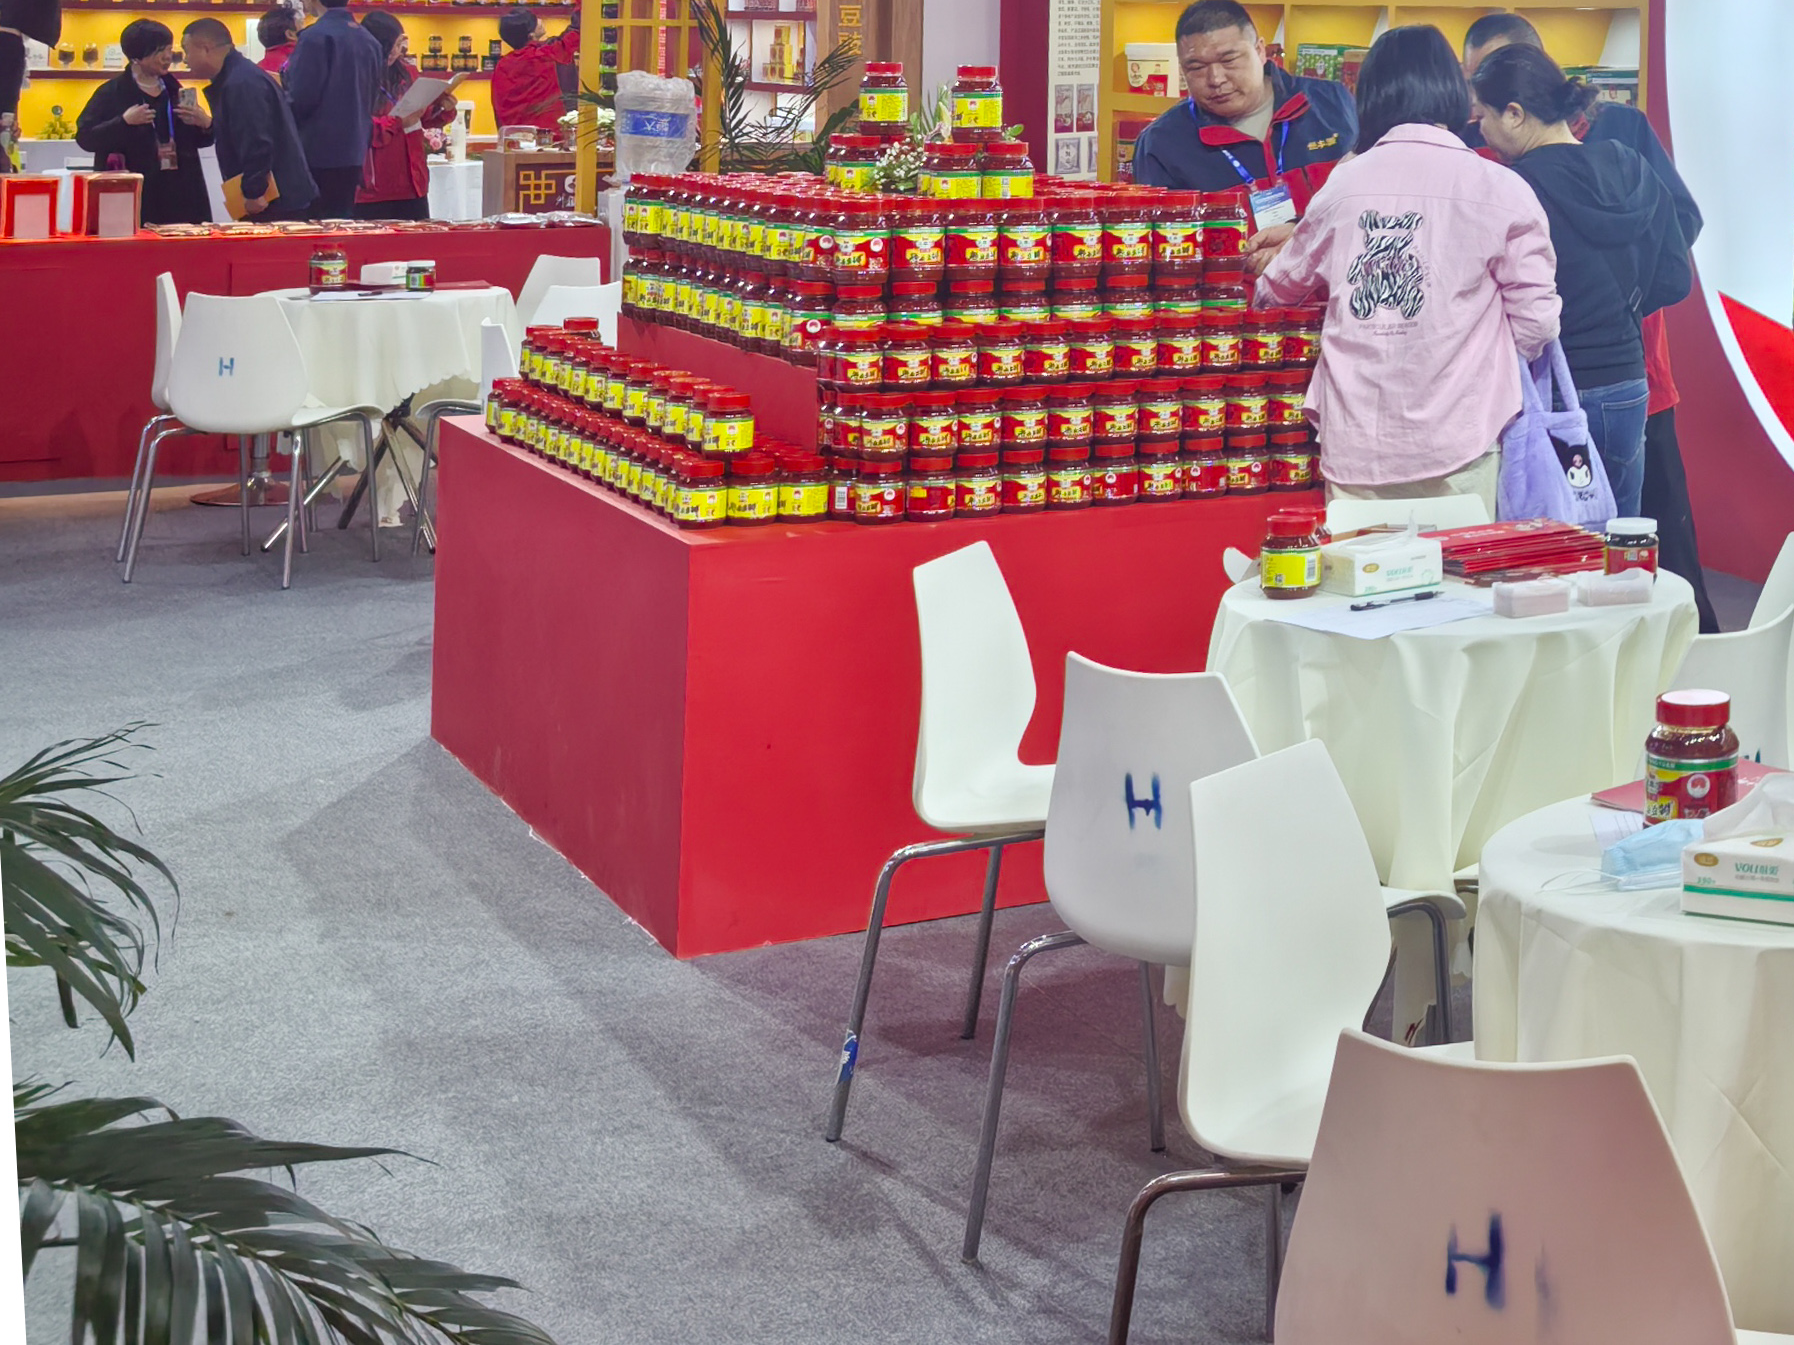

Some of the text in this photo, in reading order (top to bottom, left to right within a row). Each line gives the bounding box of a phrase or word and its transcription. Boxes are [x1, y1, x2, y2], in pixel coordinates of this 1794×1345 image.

[218, 357, 235, 377] H
[1124, 771, 1163, 831] H
[1445, 1209, 1507, 1312] H
